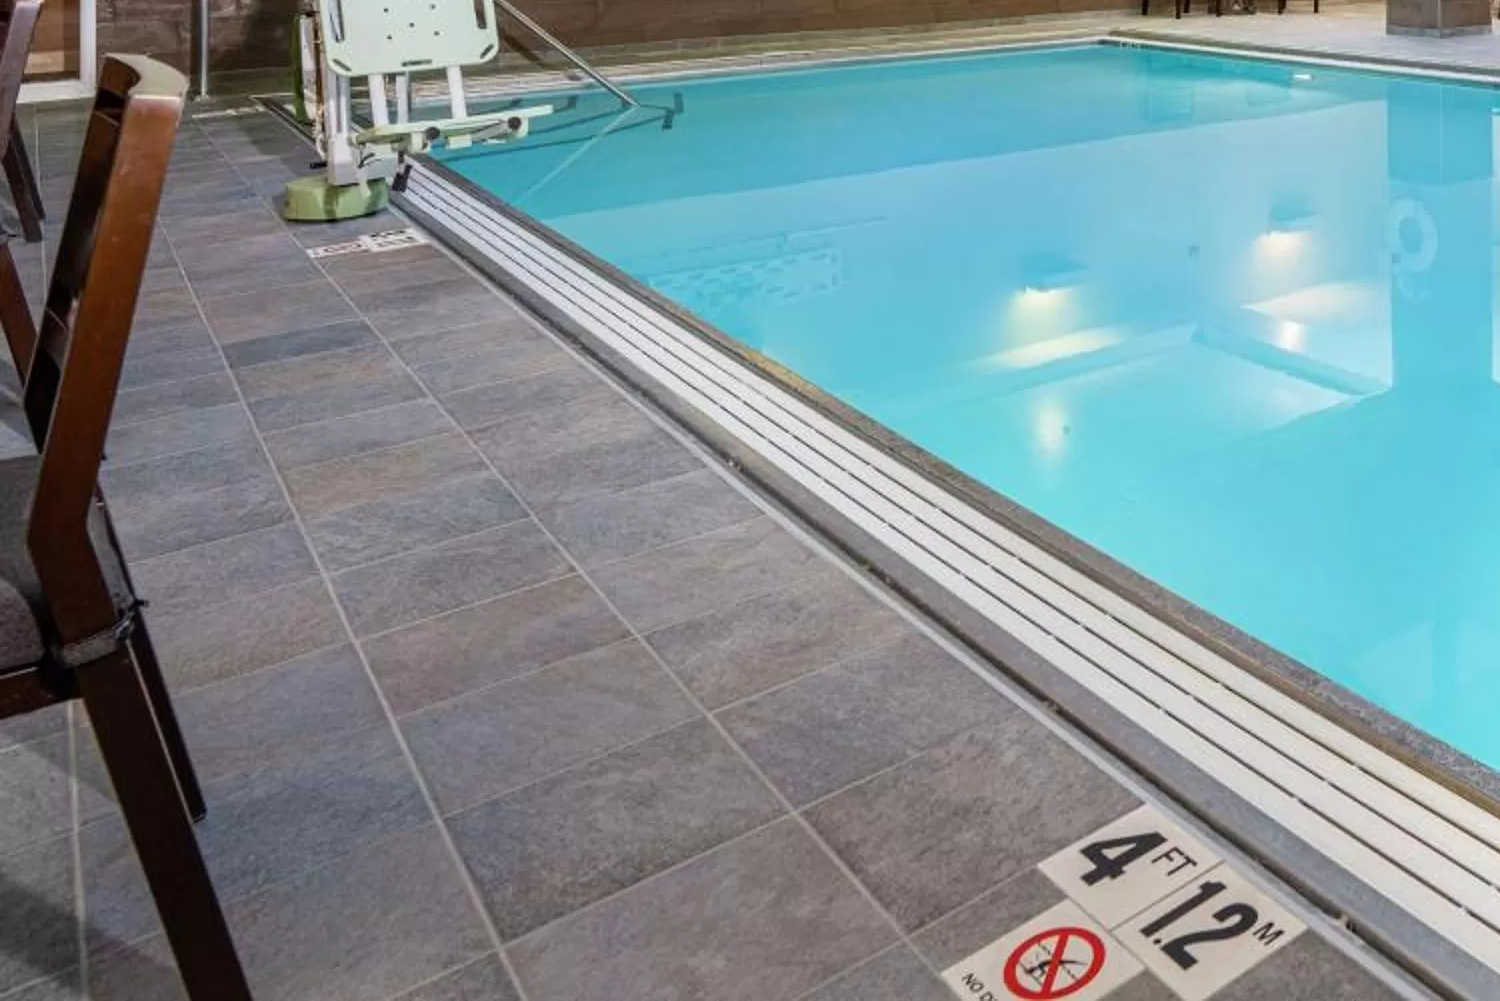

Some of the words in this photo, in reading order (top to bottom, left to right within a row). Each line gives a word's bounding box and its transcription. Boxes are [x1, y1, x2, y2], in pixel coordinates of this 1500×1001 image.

[1079, 831, 1168, 887] 4
[1151, 846, 1198, 877] FT
[1139, 880, 1259, 971] 1.2
[1252, 921, 1286, 947] M
[961, 972, 985, 993] NO
